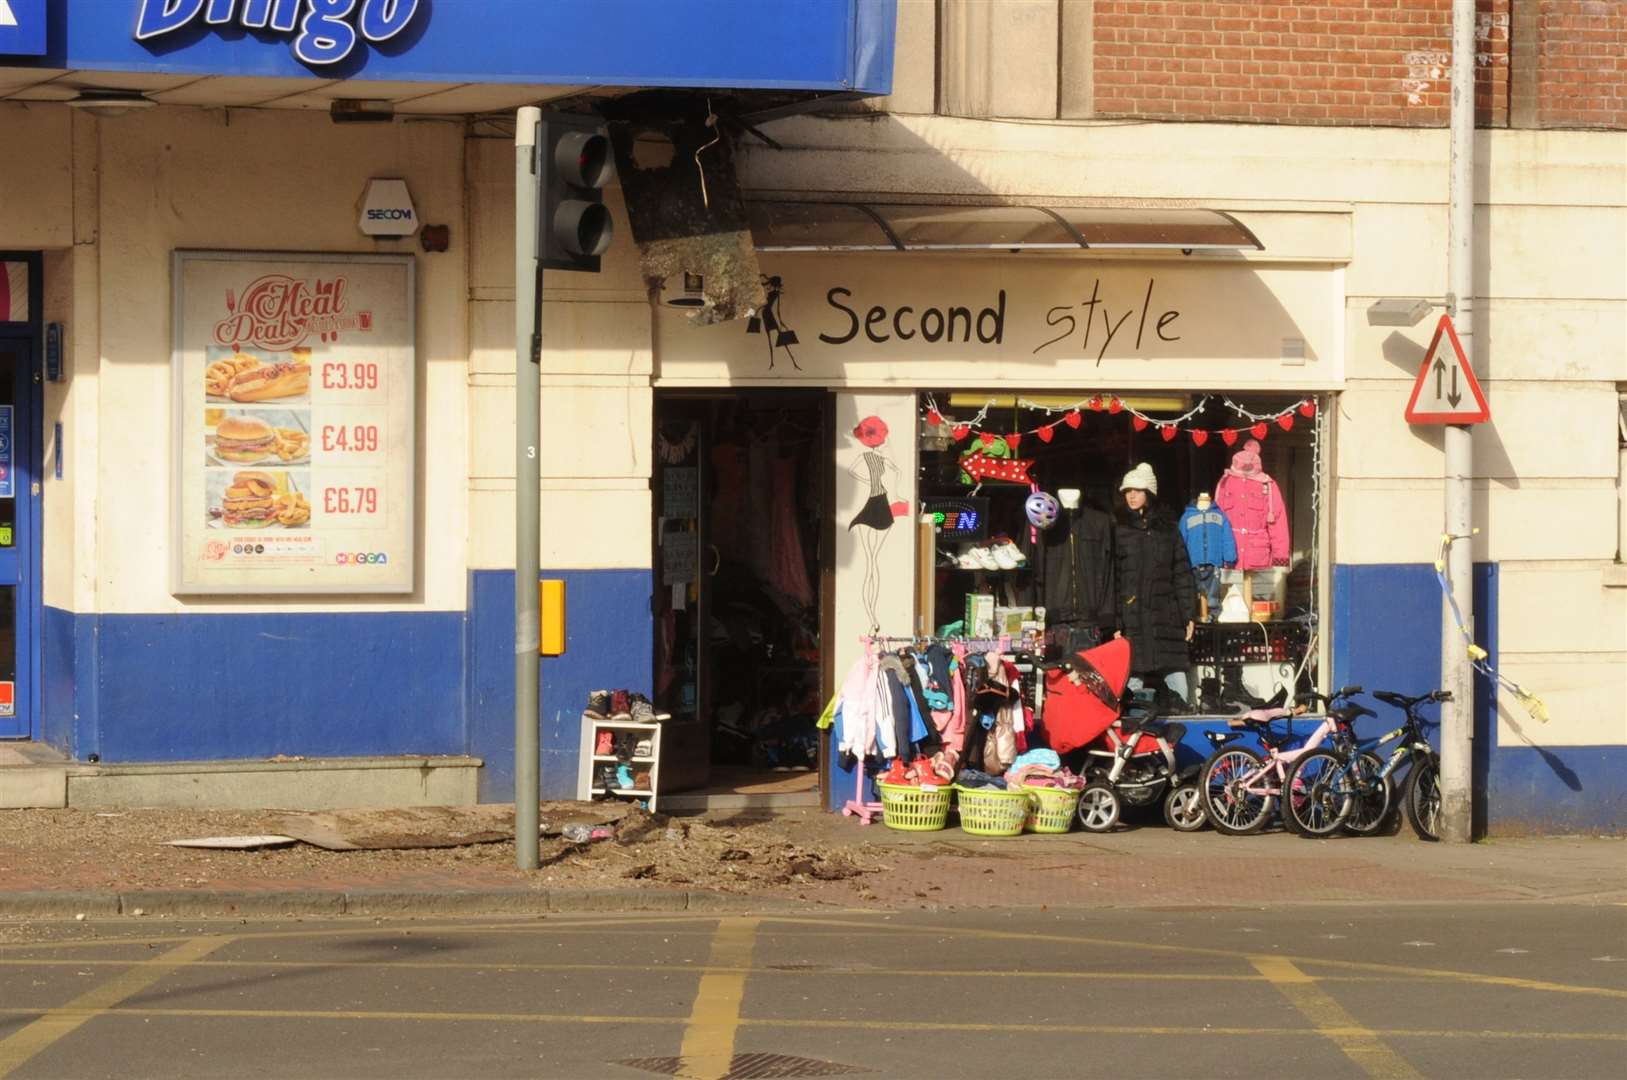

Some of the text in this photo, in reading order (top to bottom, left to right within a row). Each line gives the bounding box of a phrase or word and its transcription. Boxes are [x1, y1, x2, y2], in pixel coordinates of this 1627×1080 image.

[367, 208, 412, 220] SECOM
[256, 279, 346, 318] Meal
[215, 311, 301, 344] Deals
[818, 278, 1182, 367] Second style
[321, 362, 378, 390] £3.99
[321, 425, 378, 452] £4.99
[527, 445, 536, 459] 3
[323, 486, 378, 514] £6.79
[931, 512, 977, 529] PEN
